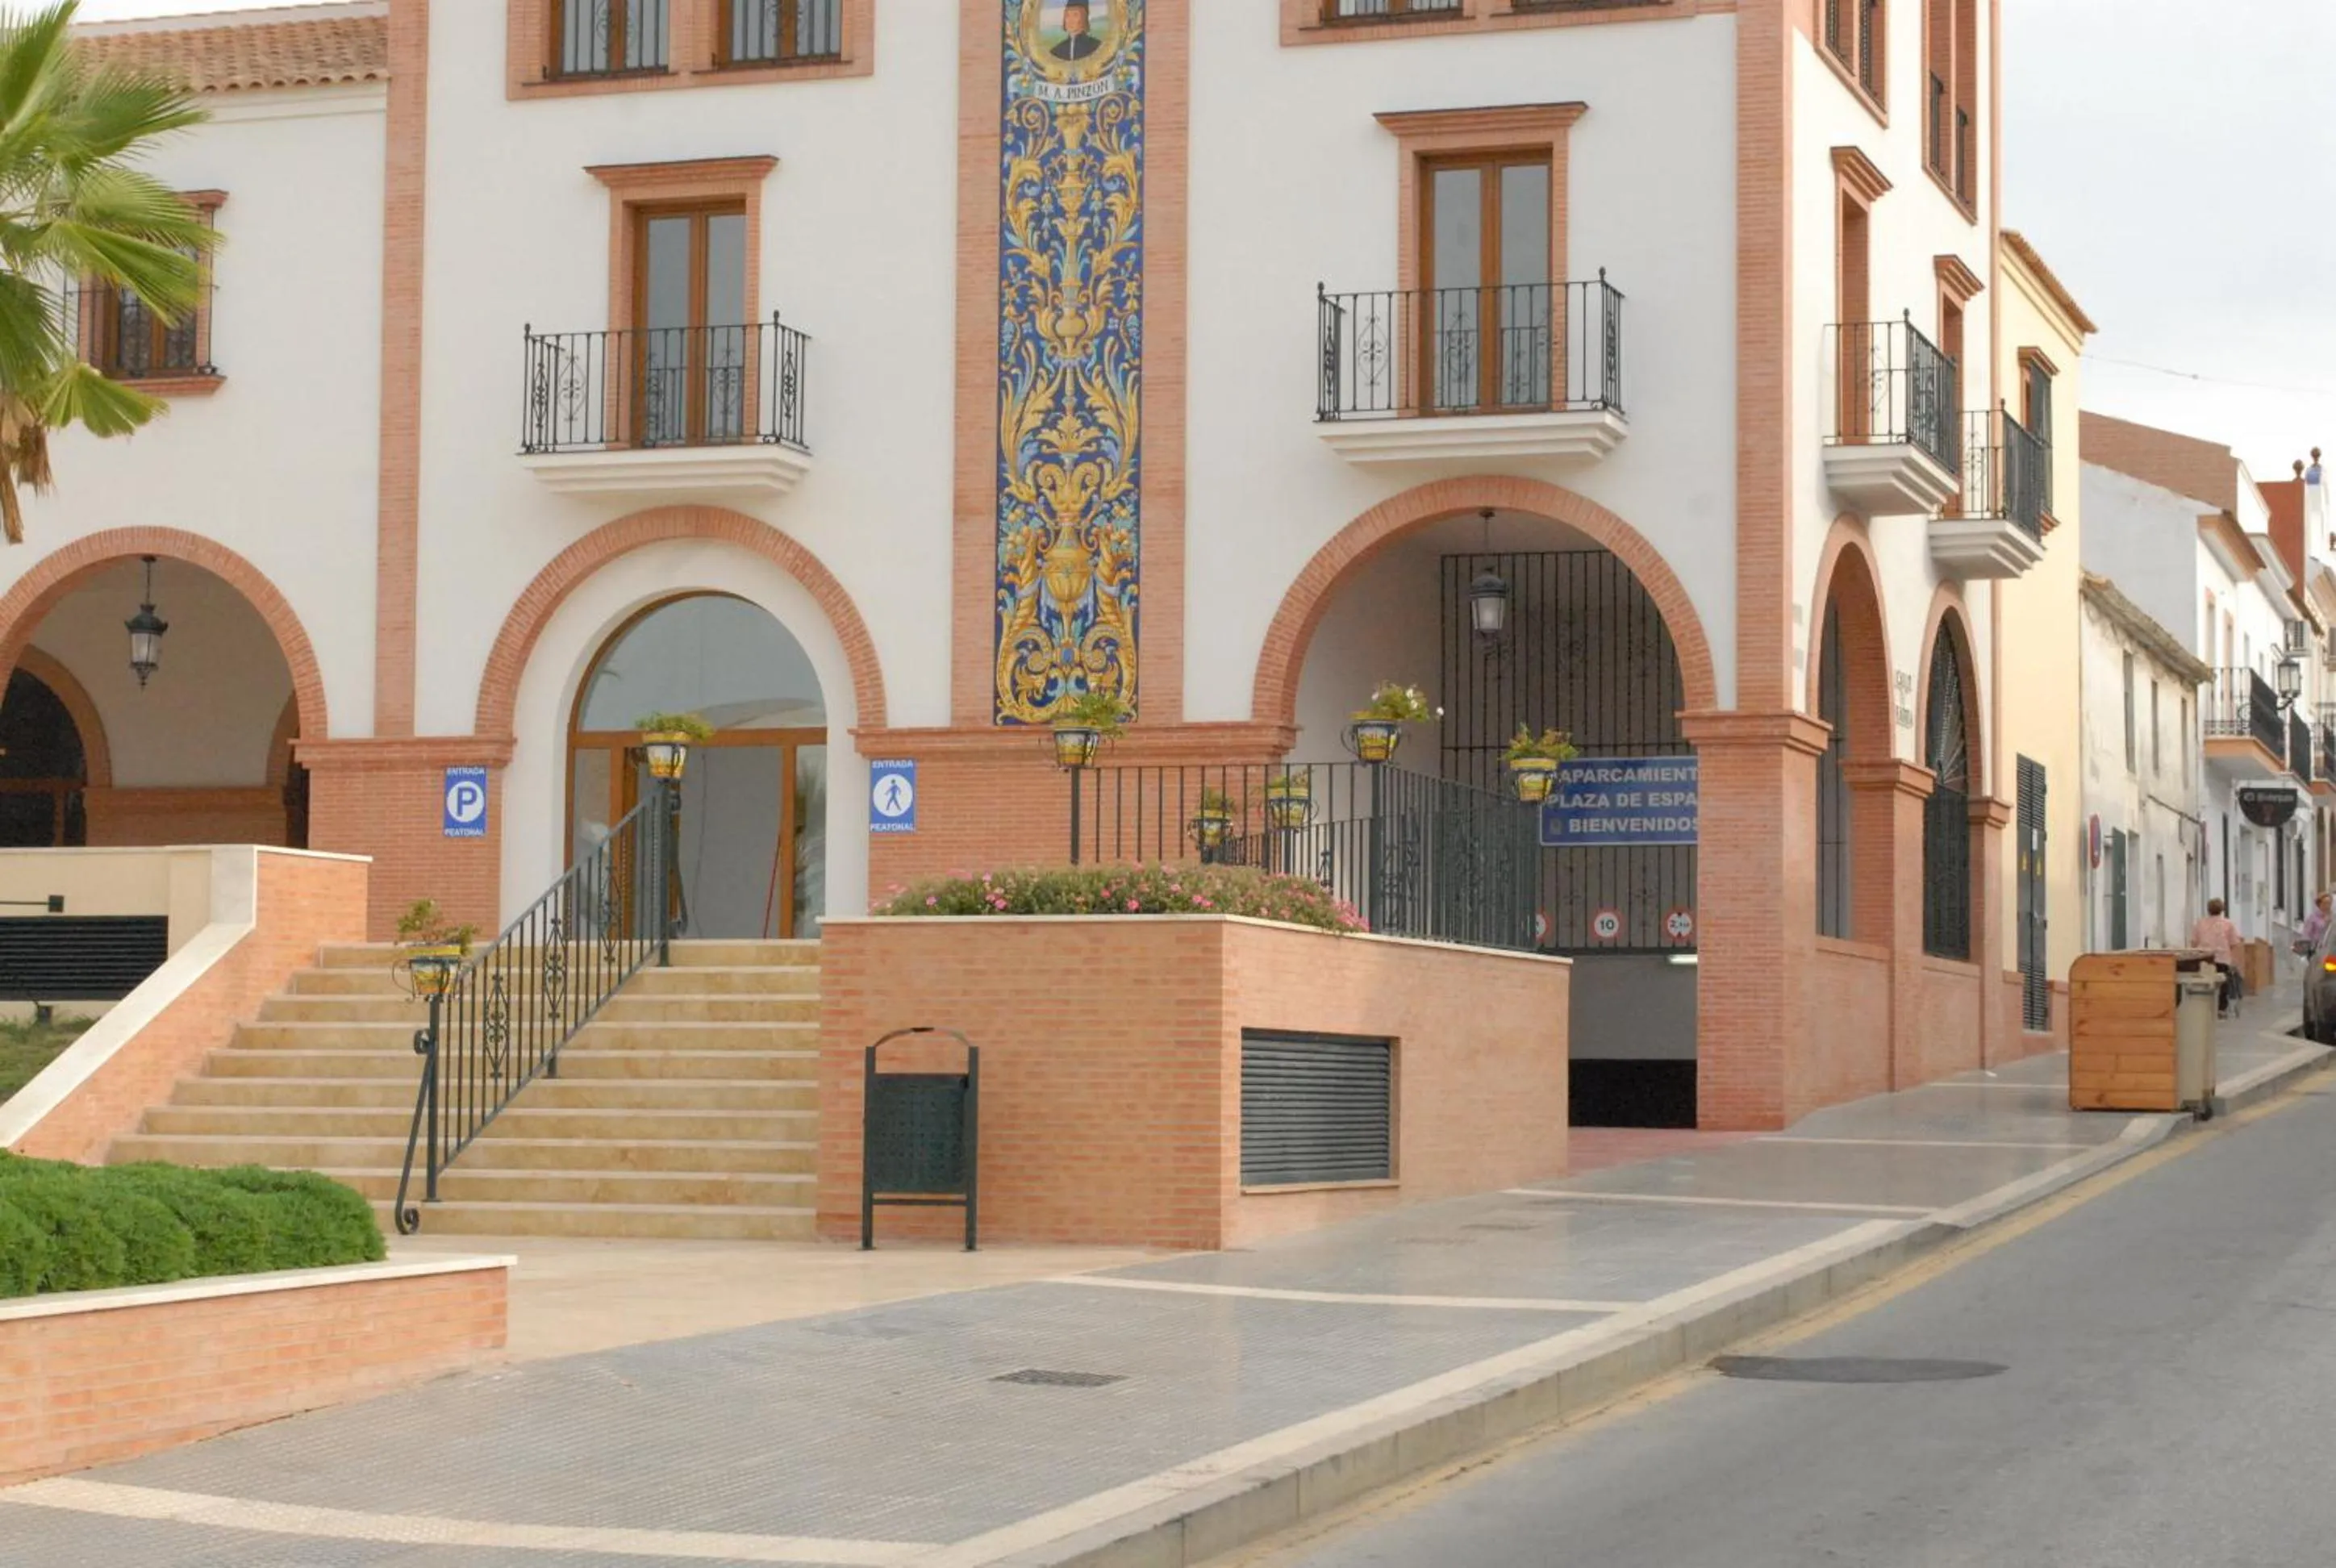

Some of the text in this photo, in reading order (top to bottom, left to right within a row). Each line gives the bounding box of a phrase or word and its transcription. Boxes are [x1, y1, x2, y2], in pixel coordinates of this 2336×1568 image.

[872, 760, 913, 768] ENTRADA
[447, 767, 485, 775] ENTRADA
[457, 786, 478, 817] P
[1547, 792, 1610, 808] PLAZA
[1616, 792, 1642, 807] DE
[1600, 920, 1614, 929] 10
